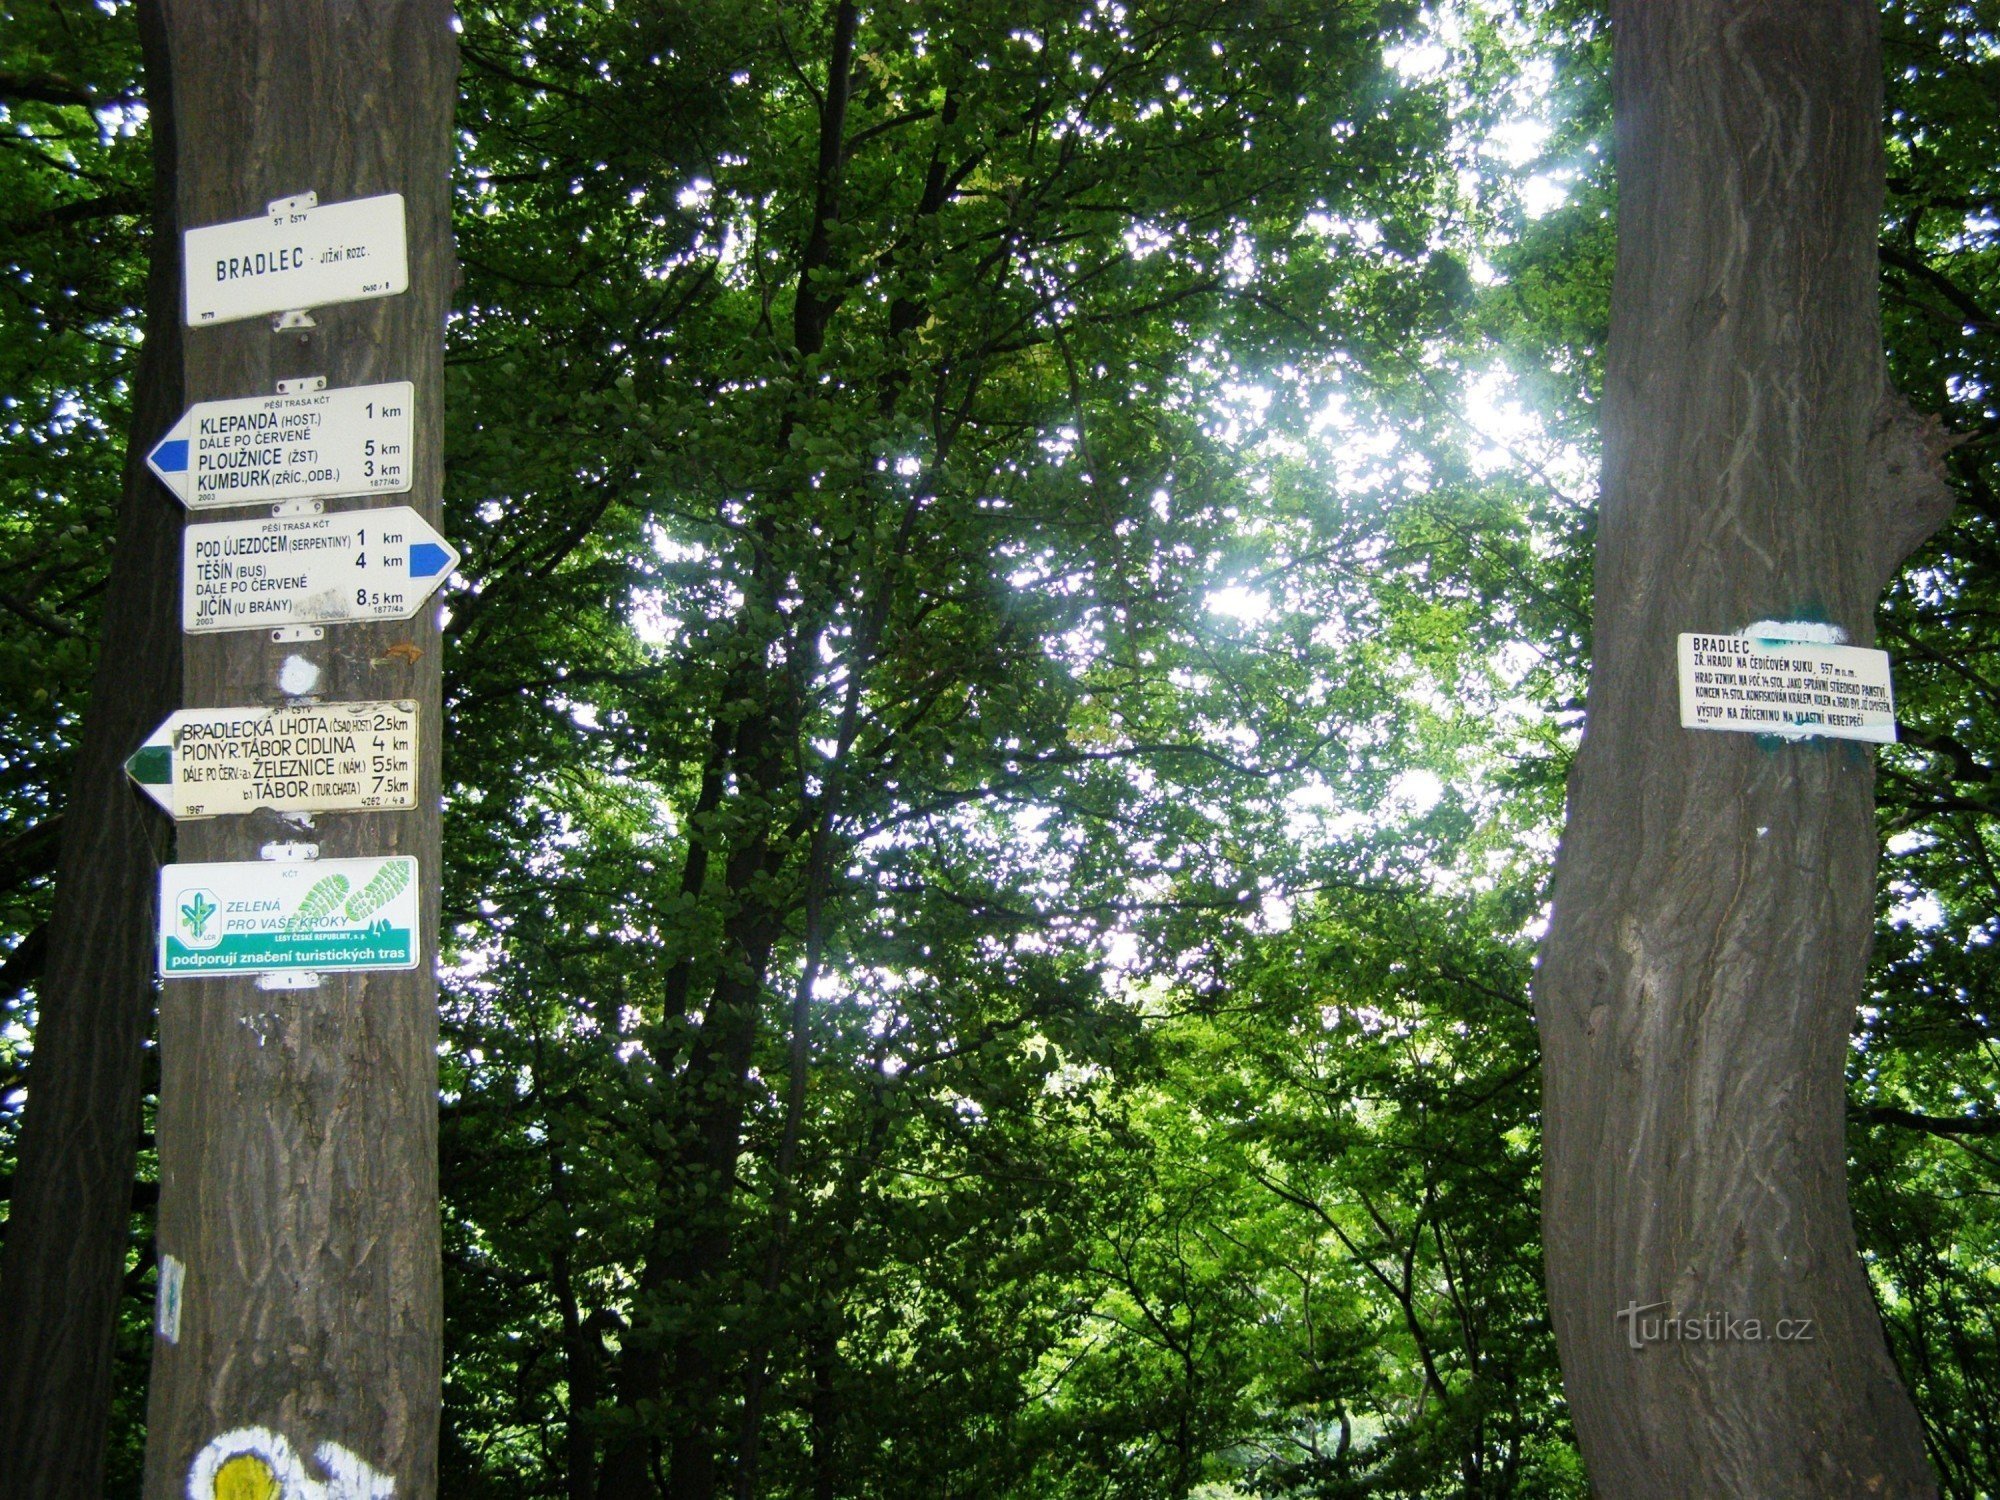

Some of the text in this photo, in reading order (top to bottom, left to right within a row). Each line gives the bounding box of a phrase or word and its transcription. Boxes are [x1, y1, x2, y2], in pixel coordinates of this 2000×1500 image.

[274, 218, 284, 226] ST
[216, 247, 304, 282] BRADLEC
[320, 245, 344, 264] JIŽNÍ
[346, 246, 371, 260] ROZC.
[284, 398, 312, 408] TRASA
[314, 396, 330, 404] KČT
[200, 402, 401, 435] KLEPANDA (HOST.) 1 km
[200, 427, 311, 450] DÁLE PO ČERVENÉ
[199, 440, 400, 471] PLOUŽNICE (ŽST) 5 km
[198, 469, 270, 491] KUMBURK
[364, 460, 374, 477] 3
[381, 464, 400, 475] km
[370, 478, 400, 488] 1877/4b
[283, 521, 311, 530] TRASA
[313, 520, 330, 528] KČT
[196, 529, 403, 558] POD ÚJEZDCEM (SERPENTINY) 1 km
[197, 552, 403, 581] TĚŠÍN (BUS) 4 km
[196, 574, 308, 596] DÁLE PO ČERVENÉ
[196, 588, 403, 617] JIČÍN (U BRÁNY) 8,5 km
[196, 618, 214, 626] 2003
[1693, 637, 1750, 654] BRADLEC
[1706, 654, 1732, 668] HRADU
[1736, 656, 1748, 668] NA
[1750, 654, 1790, 672] ČEDIČOVÉM
[1820, 662, 1834, 675] 557
[1694, 672, 1713, 684] HRAD
[1738, 674, 1748, 686] NA
[1786, 676, 1802, 689] JAKO
[1696, 686, 1720, 699] KONCEM
[1696, 702, 1723, 718] VÝSTUP
[1727, 707, 1738, 719] NA
[1783, 710, 1794, 722] NA
[182, 716, 275, 741] BRADLECKÁ
[280, 718, 328, 736] LHOTA
[182, 736, 408, 761] PIONÝR. TÁBOR CIDLINA 4 km
[184, 765, 203, 782] DÁLE
[206, 767, 216, 780] PO
[253, 758, 334, 780] ŽELEZNICE
[252, 779, 308, 800] TÁBOR
[282, 869, 298, 878] KČT
[226, 898, 281, 913] ZELENÁ
[226, 916, 349, 930] PRO VAŠE KROKY
[172, 947, 406, 968] podporují značení turistických tras
